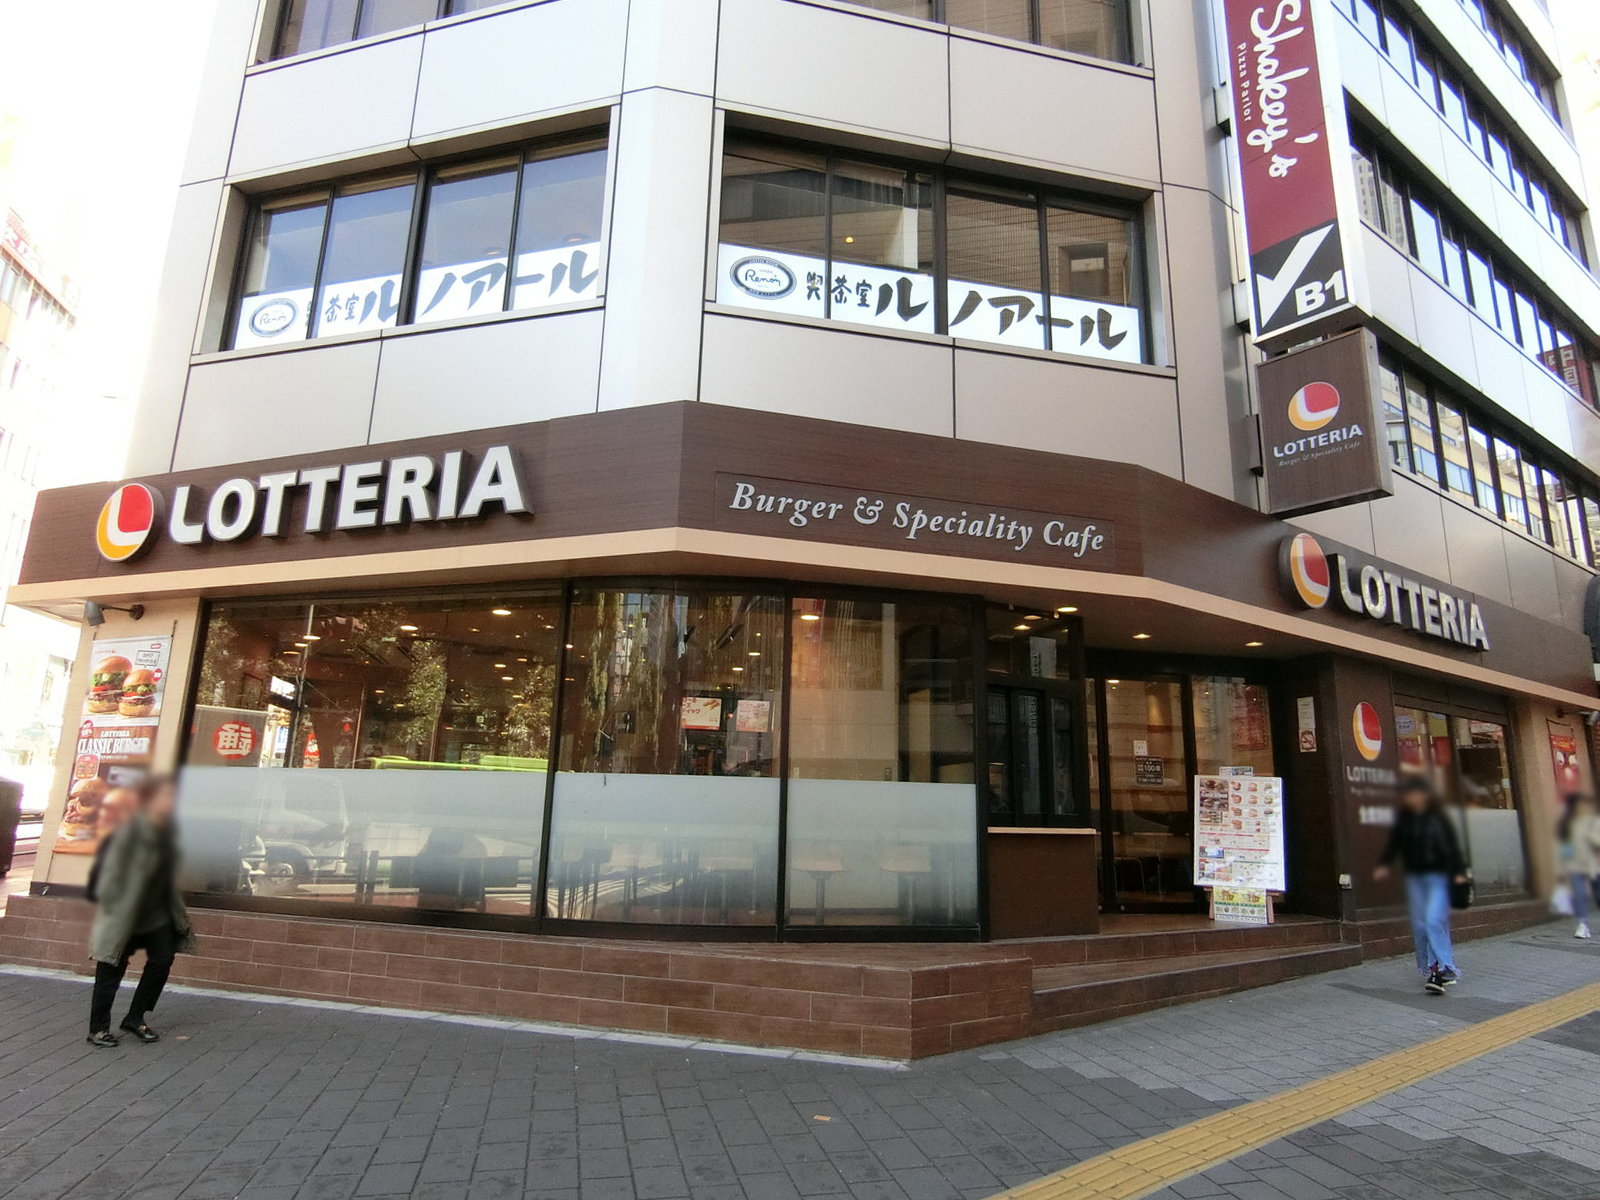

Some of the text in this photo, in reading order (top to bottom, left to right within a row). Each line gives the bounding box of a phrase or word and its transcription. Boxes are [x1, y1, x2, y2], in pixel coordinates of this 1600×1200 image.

[1241, 81, 1252, 122] Parlor
[1247, 0, 1318, 178] Shakey's
[1295, 269, 1346, 316] B1
[1273, 424, 1363, 458] LOTTERIA
[169, 444, 528, 545] LOTTERIA
[729, 482, 1104, 558] Burger & Speciality Cafe
[1337, 553, 1490, 651] LOTTERIA
[77, 737, 113, 754] CLASSIC
